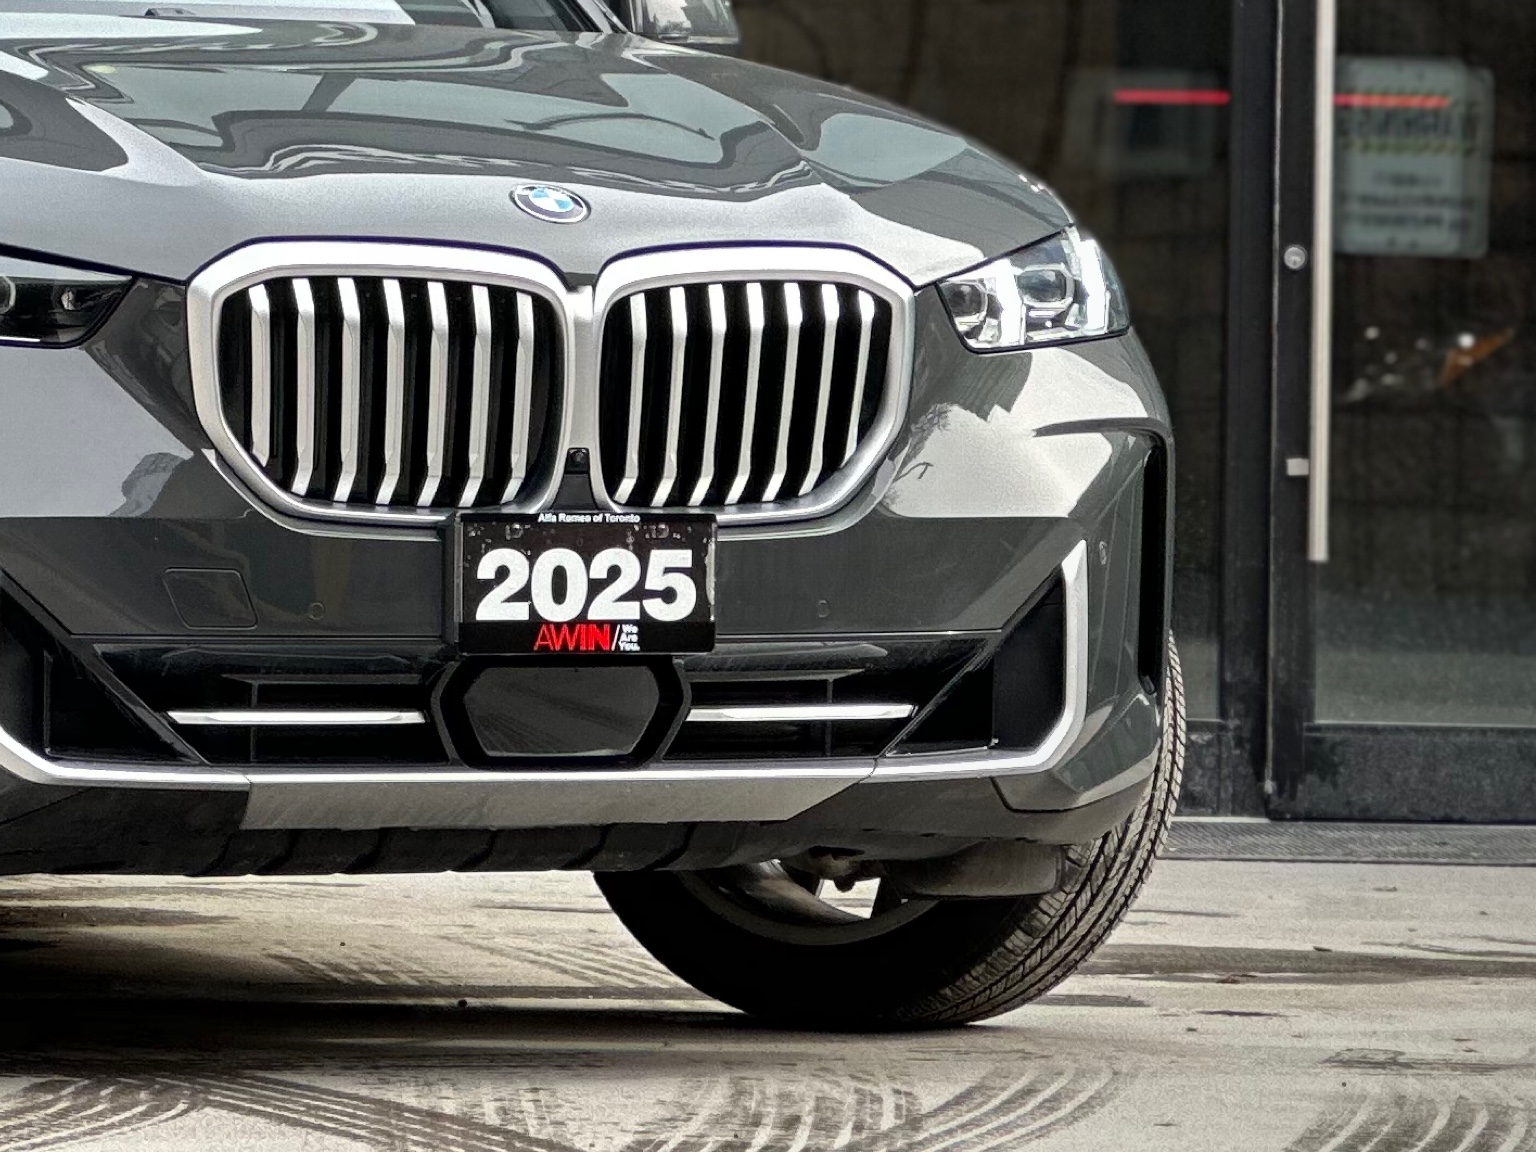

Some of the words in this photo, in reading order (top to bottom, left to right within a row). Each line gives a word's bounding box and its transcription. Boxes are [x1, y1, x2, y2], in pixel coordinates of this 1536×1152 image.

[558, 512, 591, 523] Romeo
[593, 512, 603, 523] of
[605, 512, 641, 523] Toronto
[475, 548, 696, 622] 2025
